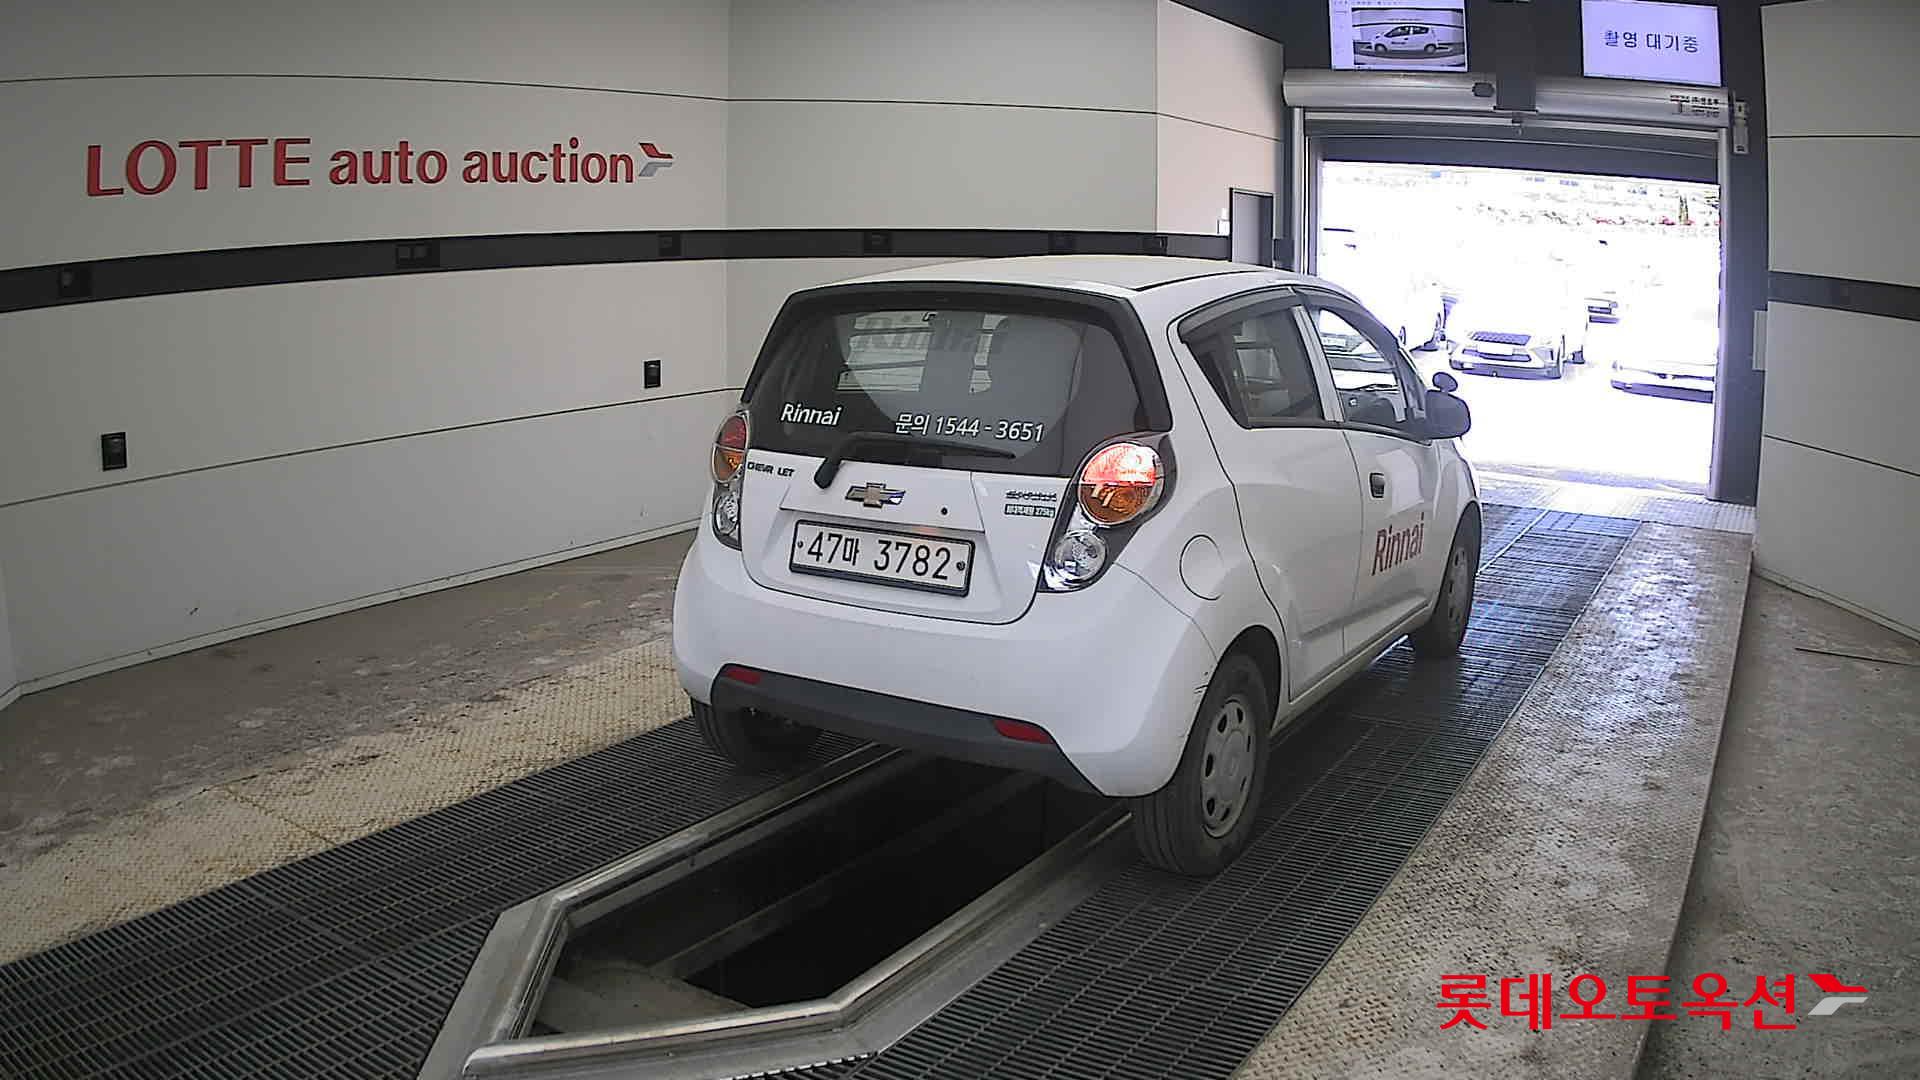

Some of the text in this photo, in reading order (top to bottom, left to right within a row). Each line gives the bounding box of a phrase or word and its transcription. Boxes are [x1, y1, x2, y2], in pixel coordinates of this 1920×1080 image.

[1604, 30, 1699, 53] 촬영 대기중
[86, 137, 636, 197] LOTTE auto auction
[780, 403, 843, 426] Rinnai
[895, 413, 931, 435] 문의
[807, 531, 951, 580] 47마 3782
[1371, 511, 1425, 576] Rinnai
